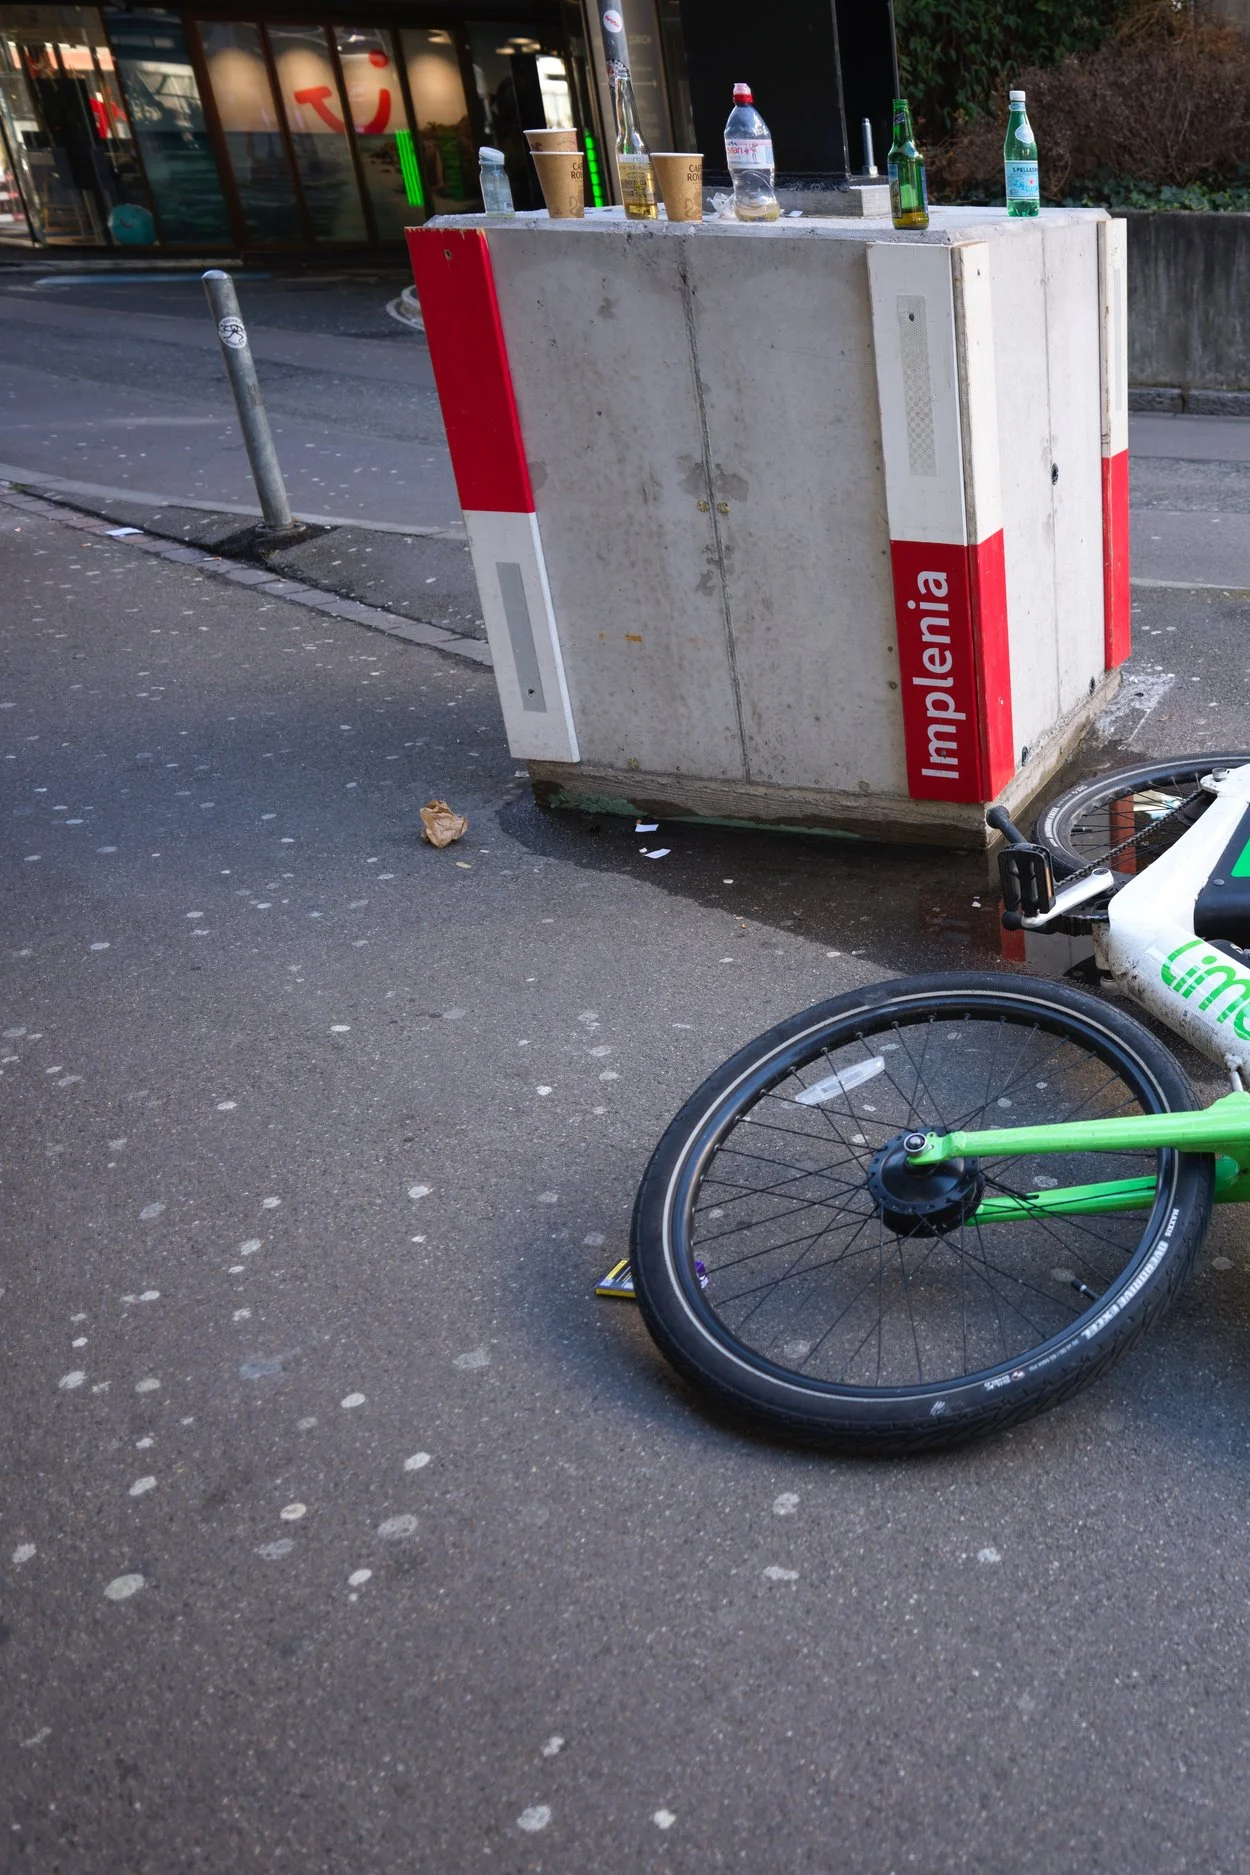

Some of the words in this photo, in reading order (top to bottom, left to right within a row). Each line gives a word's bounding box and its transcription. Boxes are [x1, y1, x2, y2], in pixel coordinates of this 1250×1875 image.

[907, 570, 967, 779] Implenia
[1164, 1208, 1180, 1238] MAXXIS
[1117, 1240, 1169, 1310] OVERDRIVE
[1080, 1303, 1120, 1340] EXCEL
